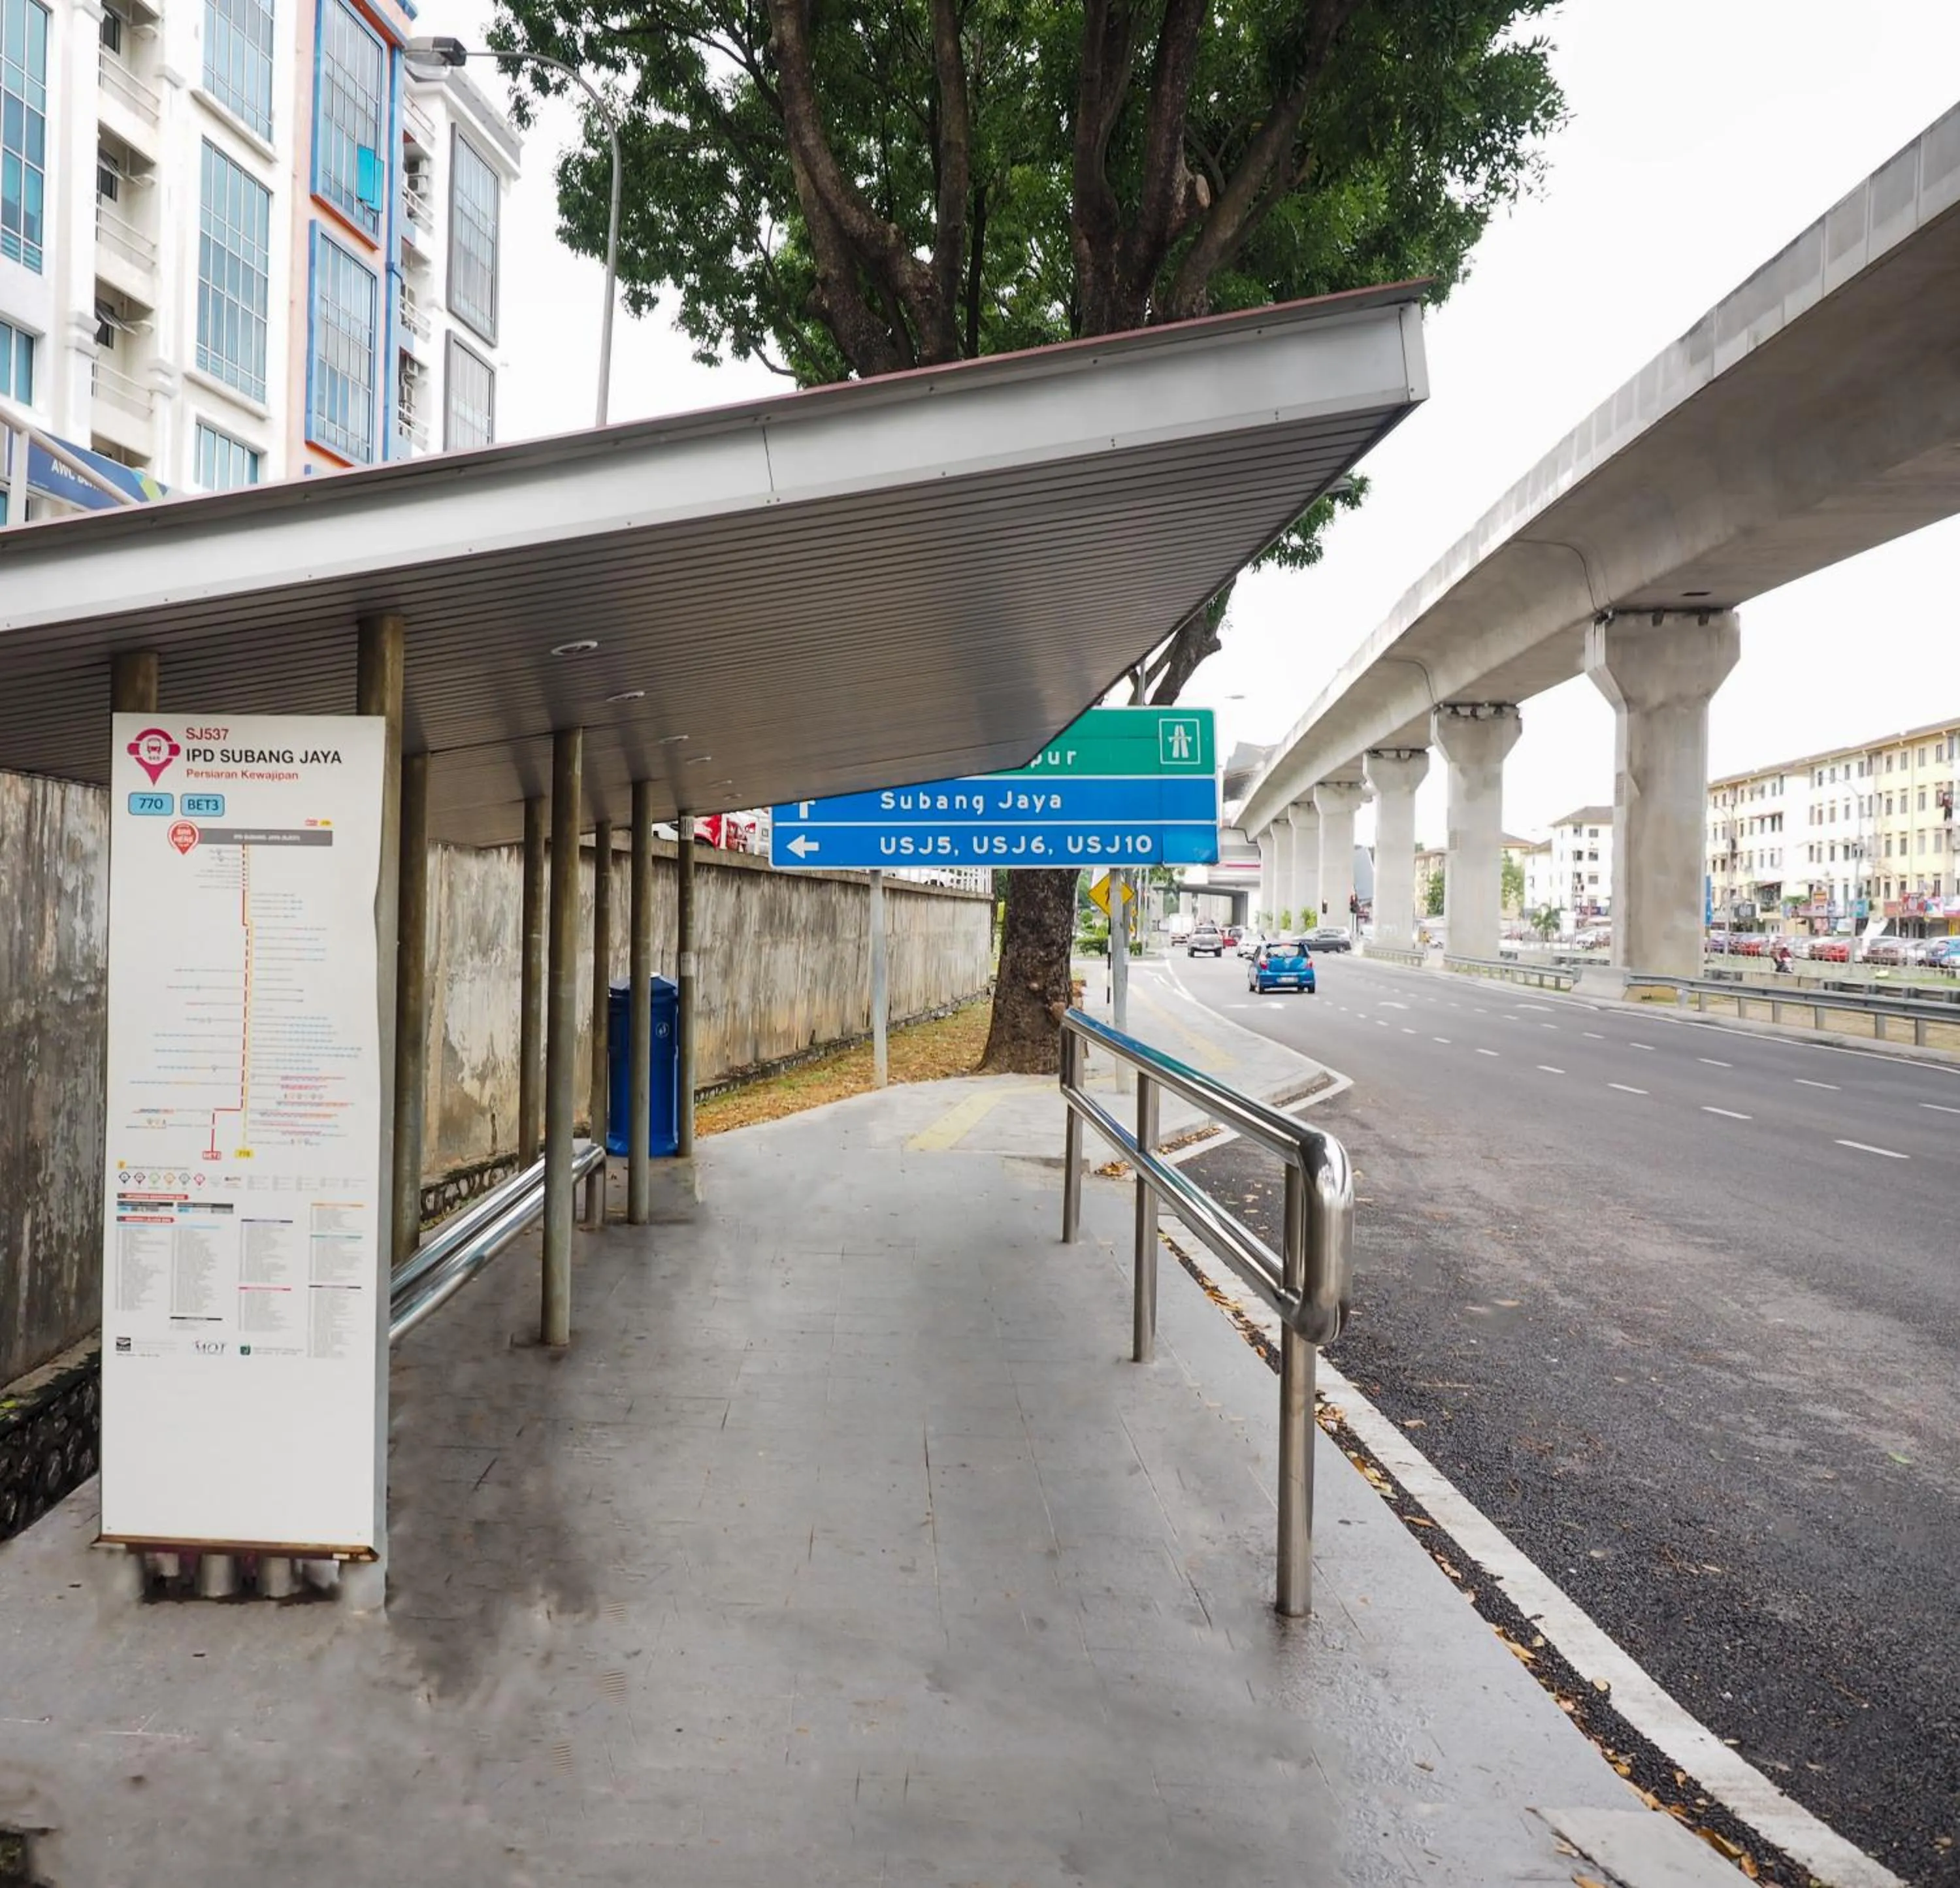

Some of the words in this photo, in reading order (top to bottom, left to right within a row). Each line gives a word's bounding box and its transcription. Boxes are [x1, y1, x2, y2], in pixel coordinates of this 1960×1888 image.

[186, 727, 229, 741] SJ537
[186, 748, 215, 762] IPD
[220, 749, 294, 764] SUBANG
[300, 750, 342, 764] JAYA
[186, 768, 237, 779] Persiaran
[241, 769, 299, 781] Kewajipan
[139, 798, 163, 809] 770
[188, 799, 219, 811] BET3
[880, 791, 985, 815] Subang
[998, 790, 1062, 813] Jaya
[879, 836, 959, 856] USJ5,
[972, 835, 1054, 856] USJ6,
[1067, 834, 1153, 854] USJ10
